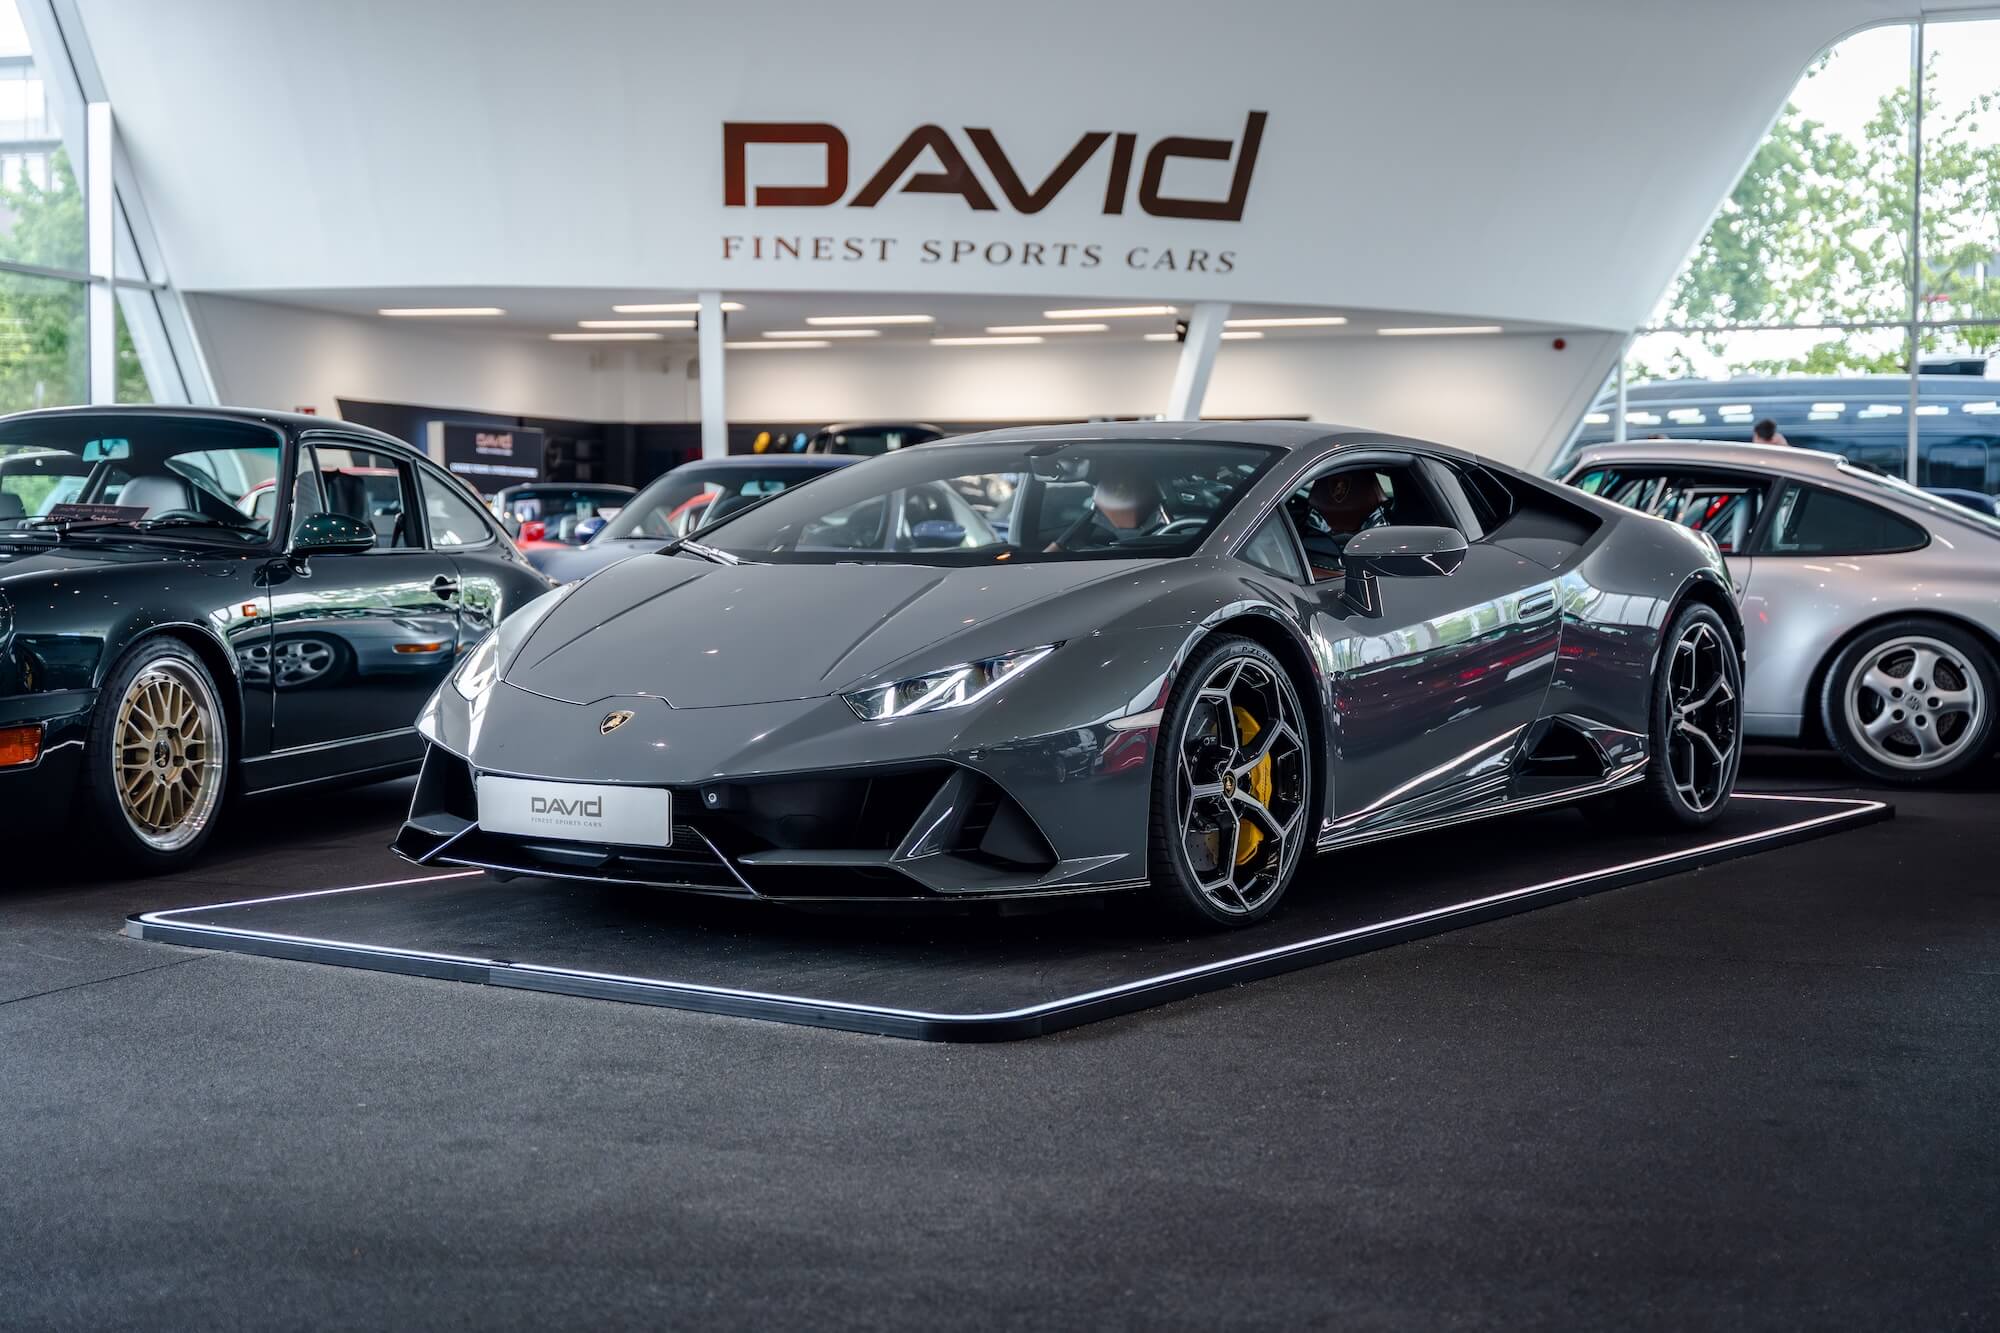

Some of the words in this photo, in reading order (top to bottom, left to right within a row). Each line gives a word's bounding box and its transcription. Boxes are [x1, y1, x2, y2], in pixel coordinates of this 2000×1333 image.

[723, 236, 896, 261] FINEST
[921, 240, 1102, 267] SPORTS
[1126, 247, 1236, 273] CARS
